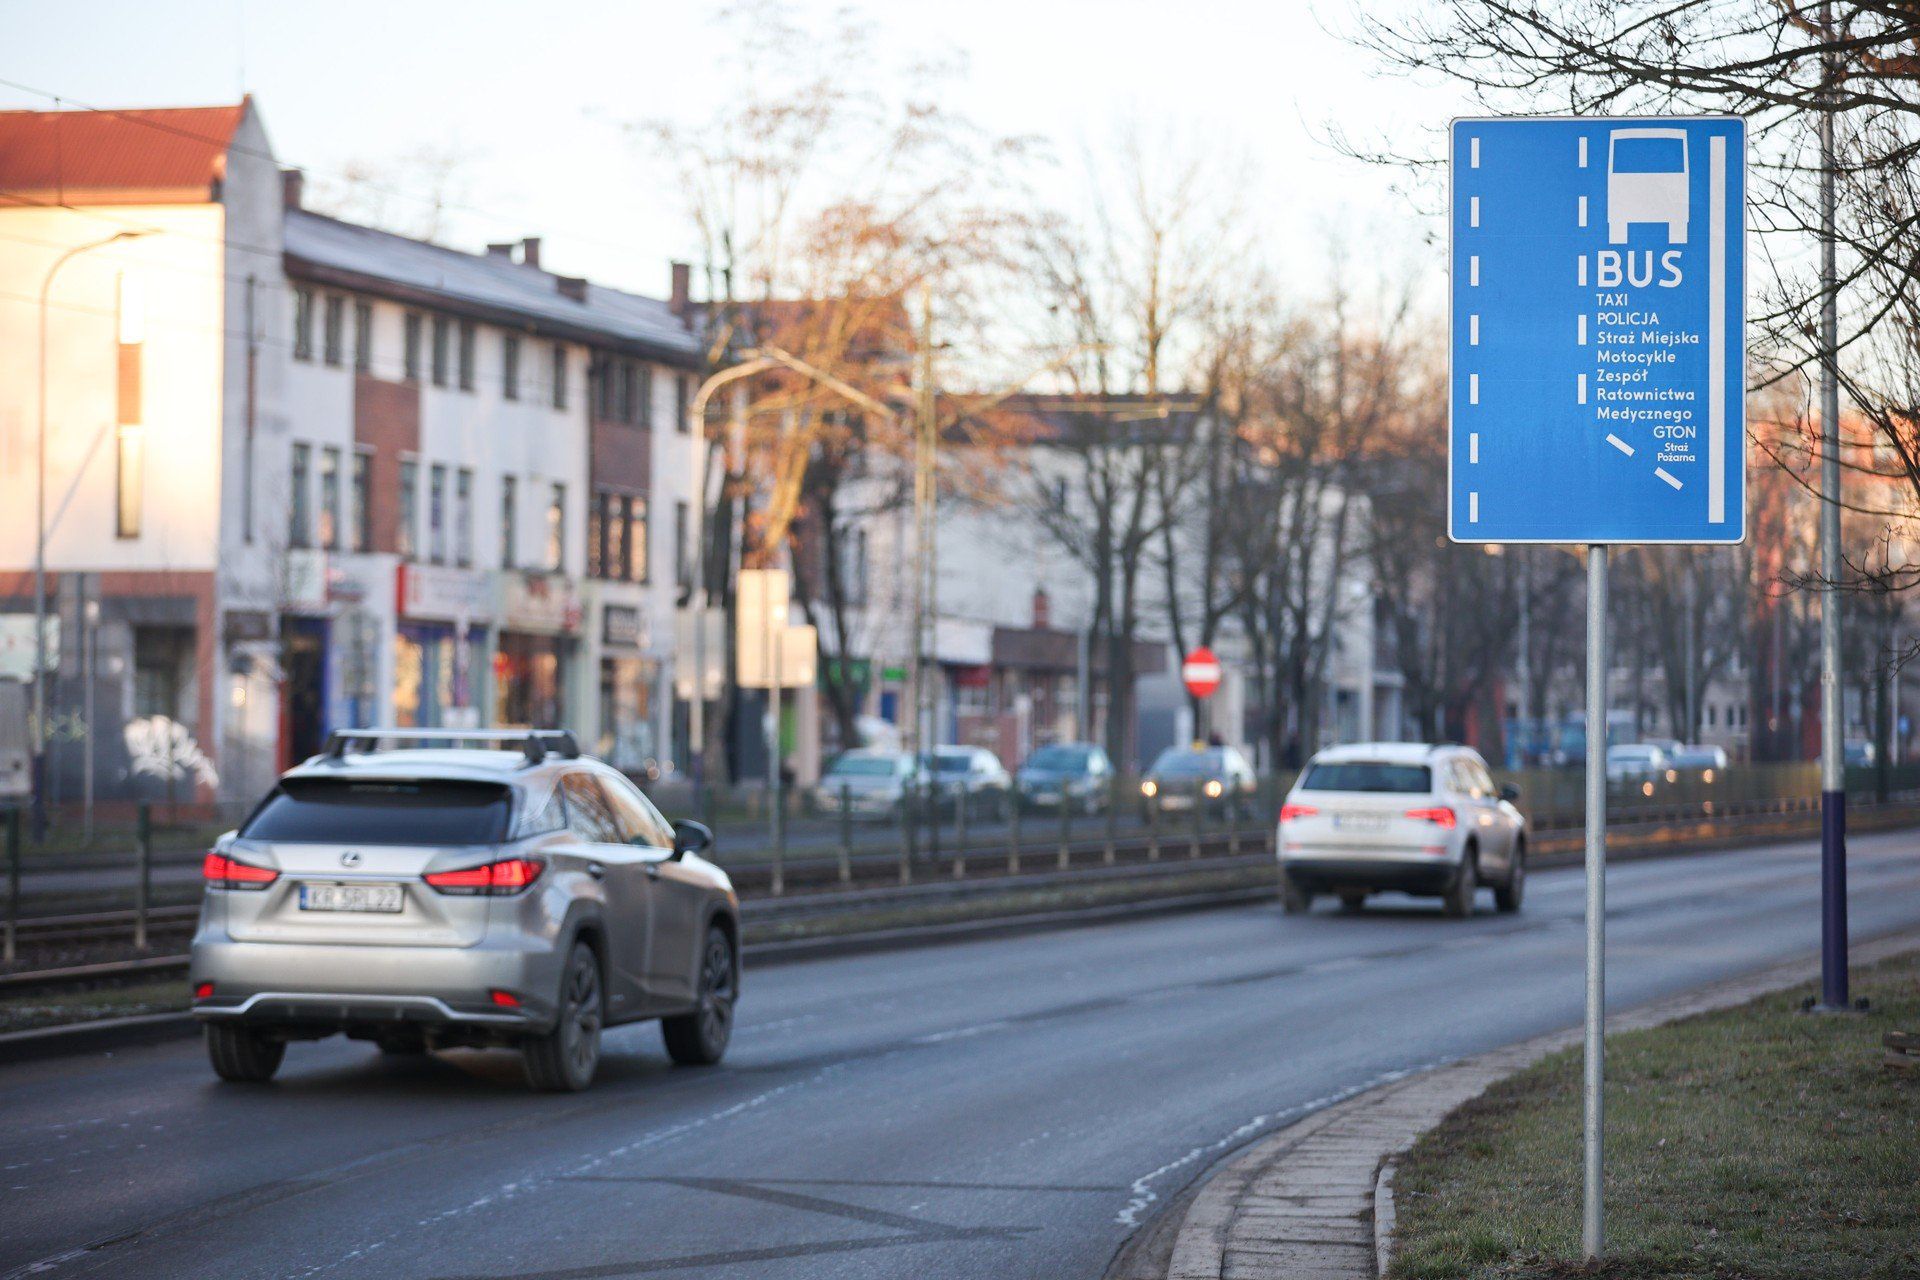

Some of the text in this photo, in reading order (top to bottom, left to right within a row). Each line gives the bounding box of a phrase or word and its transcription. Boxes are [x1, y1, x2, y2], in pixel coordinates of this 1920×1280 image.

[1598, 250, 1682, 287] BUS
[1596, 294, 1627, 306] TAXI
[1598, 312, 1659, 325] POLICJA
[1598, 331, 1699, 346] Straż Miejska
[1598, 350, 1675, 366] Motocykle
[1597, 369, 1648, 385] Zespół
[1597, 388, 1694, 400] Ratownictwa
[1598, 407, 1692, 423] Medycznego
[1654, 426, 1695, 438] GTON
[1664, 442, 1689, 452] Straż
[1657, 453, 1696, 462] Pożarna
